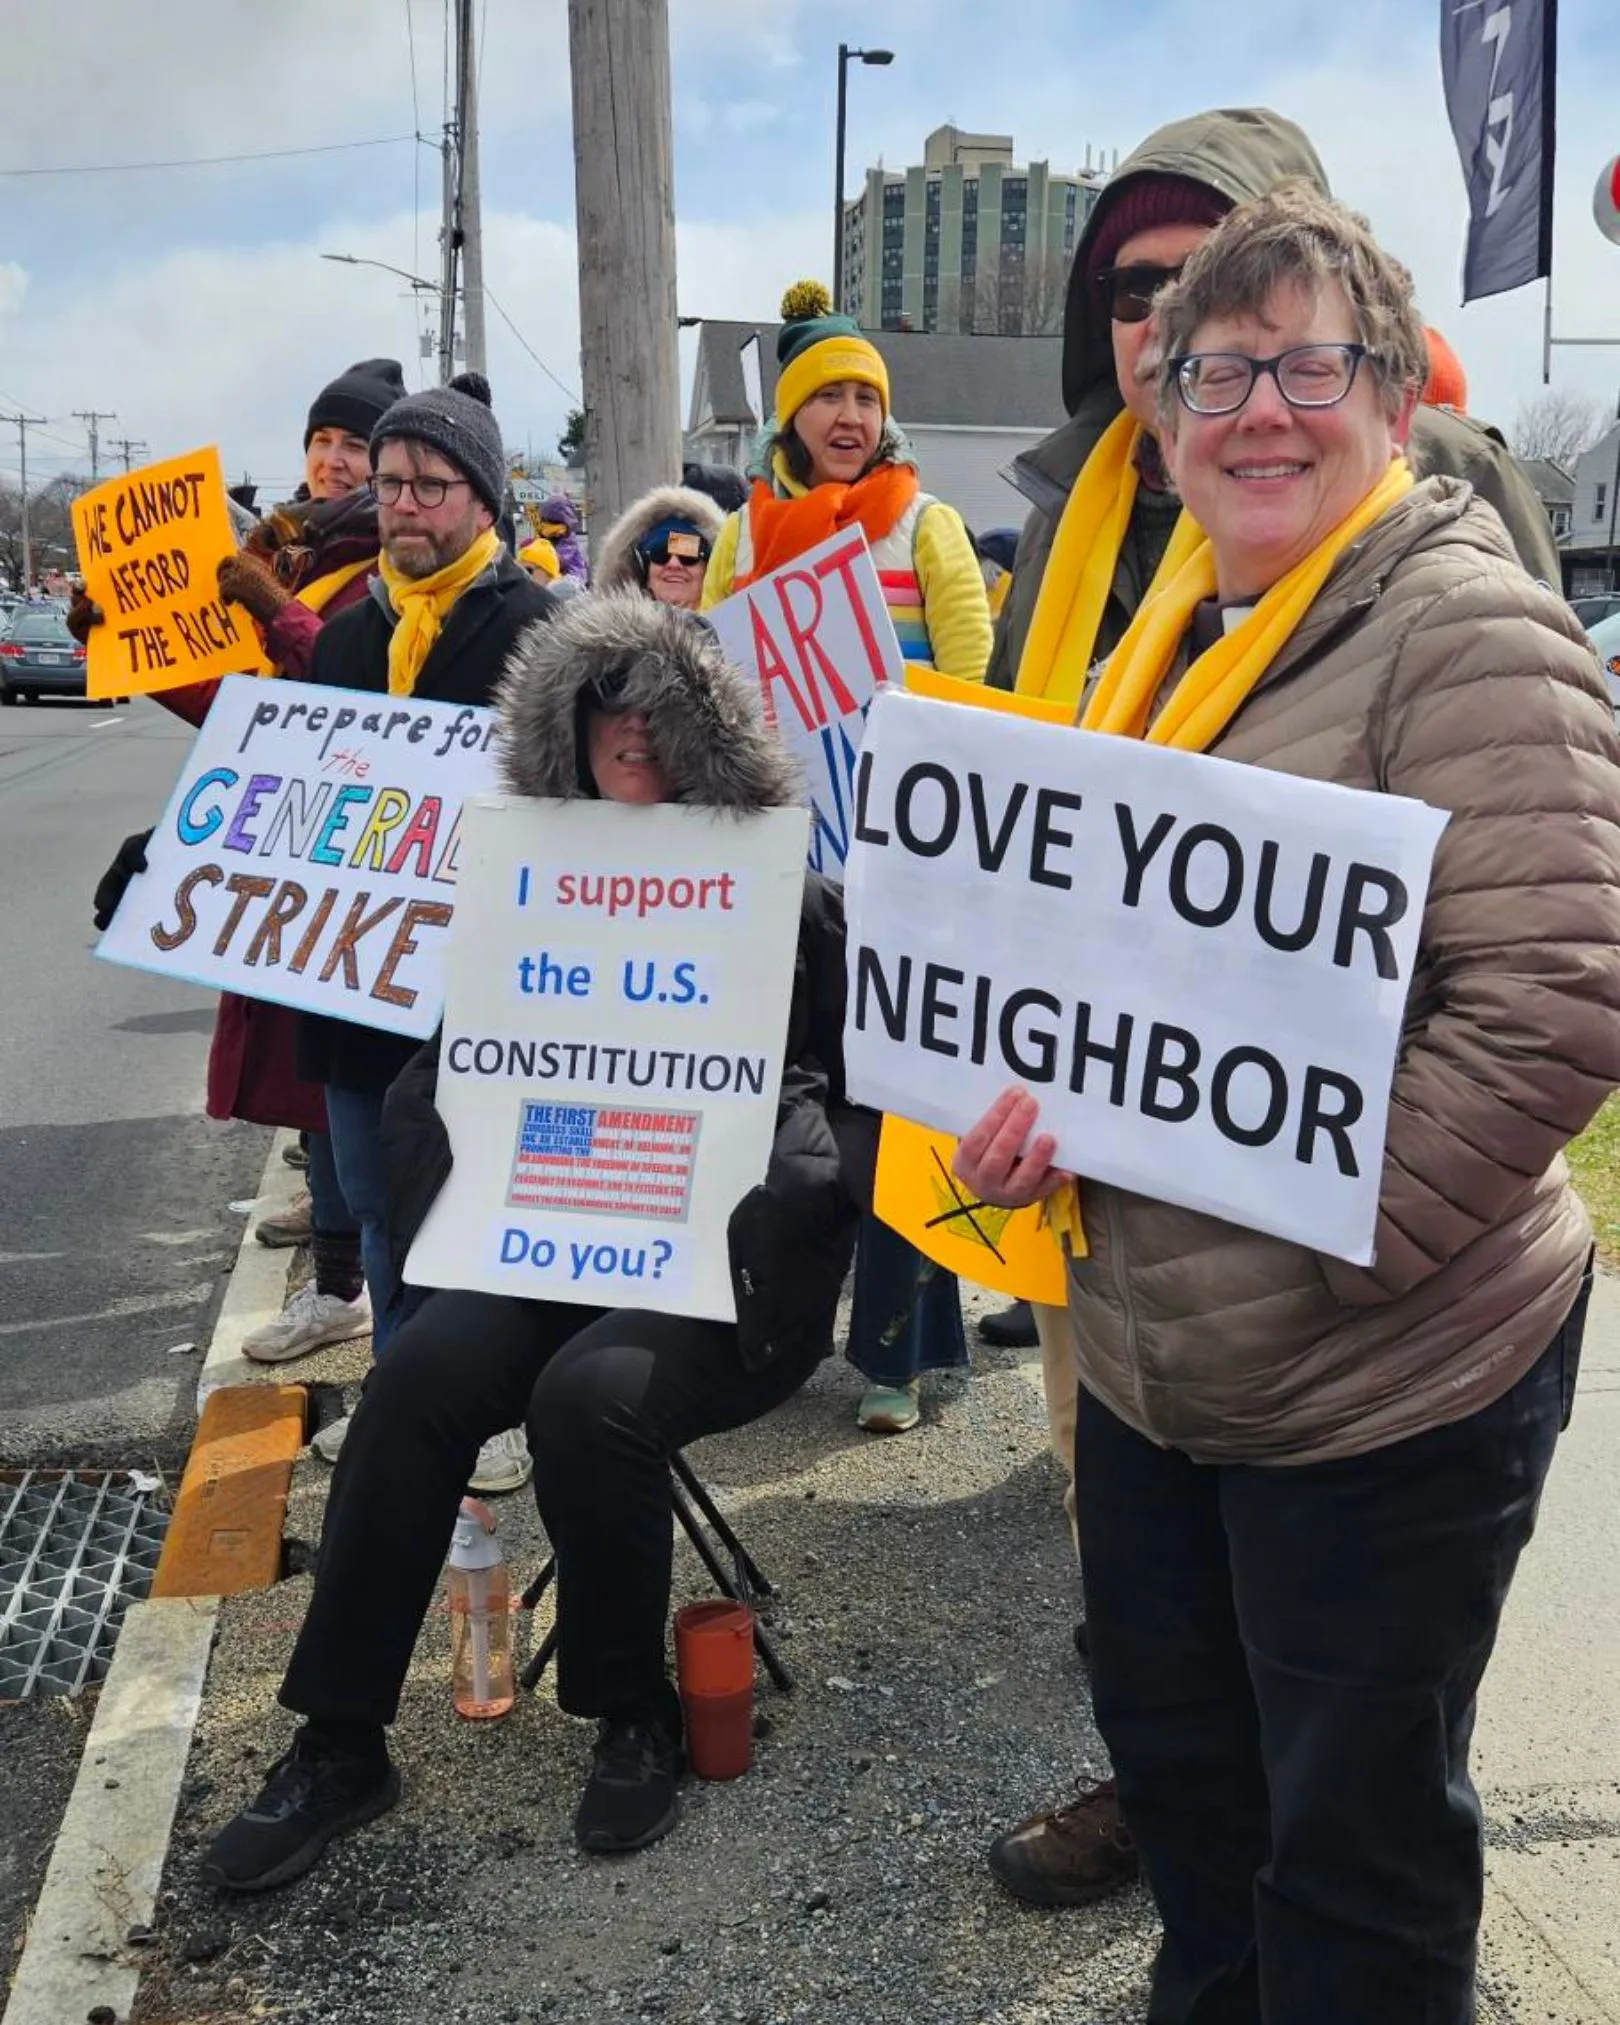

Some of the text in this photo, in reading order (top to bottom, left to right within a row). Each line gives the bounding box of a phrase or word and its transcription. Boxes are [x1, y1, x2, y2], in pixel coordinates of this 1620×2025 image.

[83, 474, 206, 562] WE CANNOT
[109, 548, 190, 614] AFFORD
[118, 602, 241, 674] THE RICH
[747, 537, 889, 734] ART
[238, 700, 432, 760] prepare
[322, 747, 371, 779] the
[177, 765, 463, 885] GENERAL
[518, 866, 735, 917] I support
[854, 750, 1082, 891] LOVE
[1114, 802, 1409, 981] YOUR
[150, 863, 454, 1009] STRIKE
[518, 953, 710, 1004] the U.S.
[448, 1037, 767, 1095] CONSTITUTION
[855, 945, 1366, 1178] NEIGHBOR
[525, 1104, 697, 1133] THE FIRST AMENDMENT
[500, 1228, 673, 1280] Do you?
